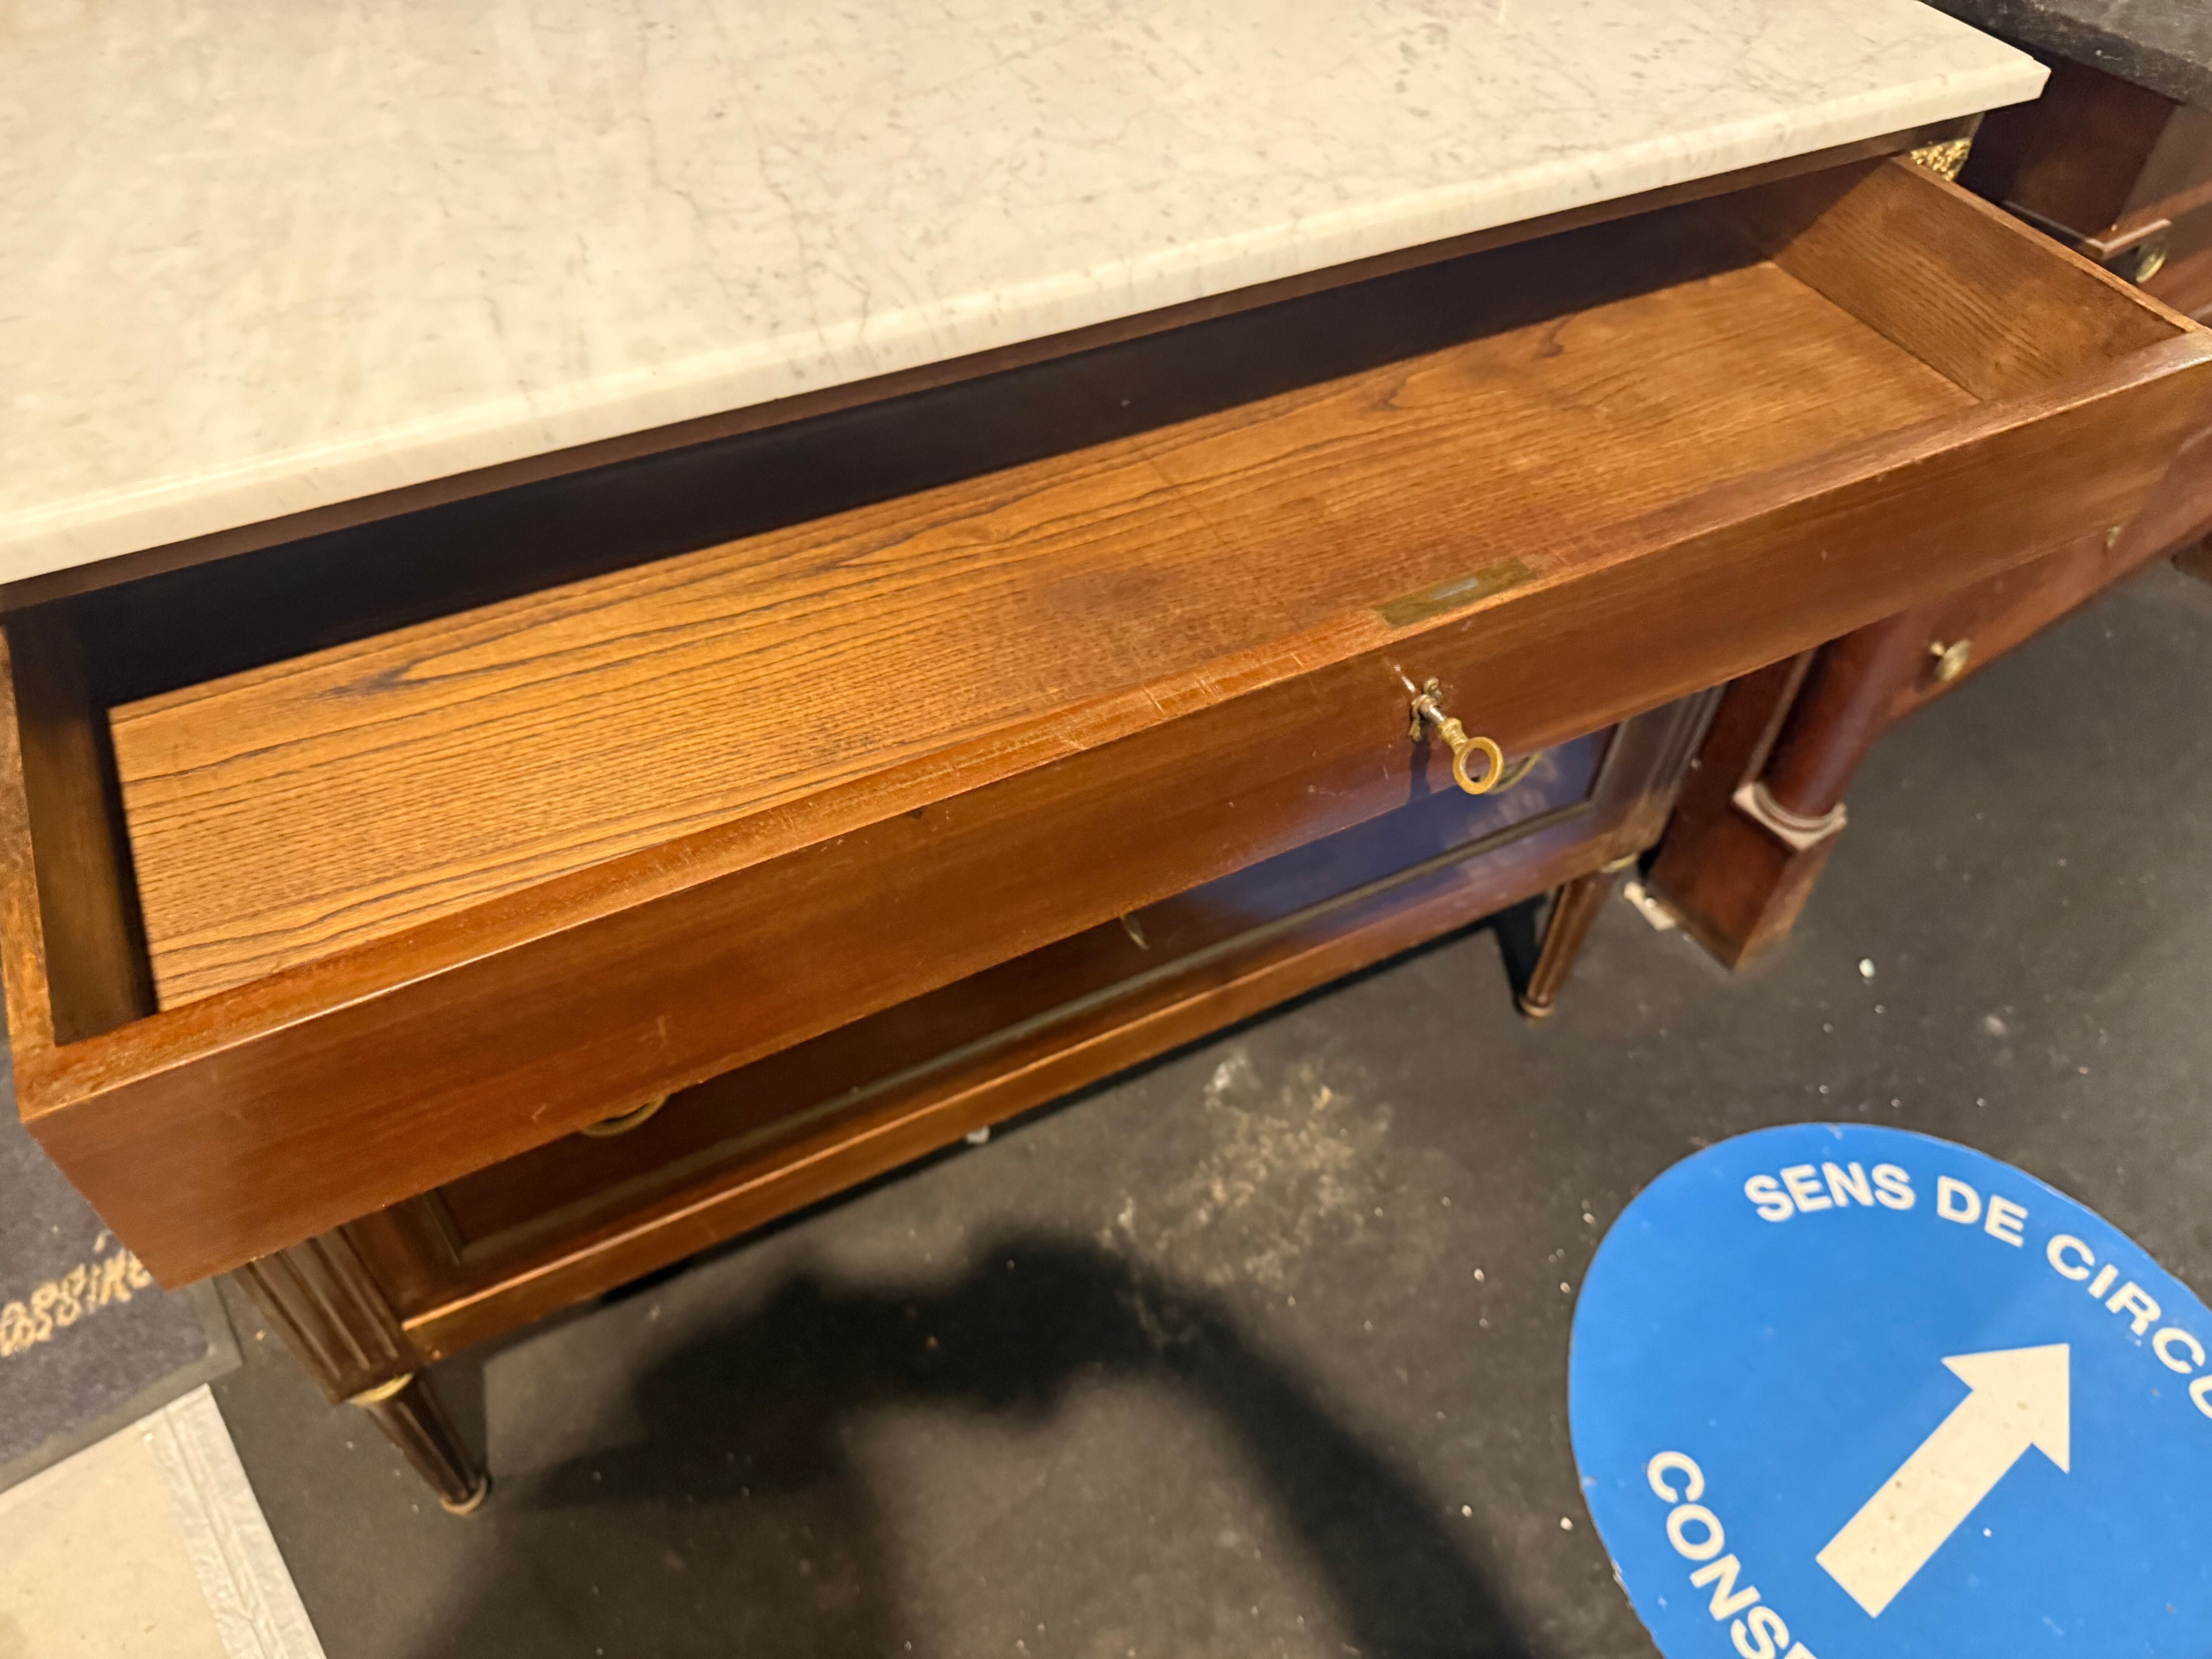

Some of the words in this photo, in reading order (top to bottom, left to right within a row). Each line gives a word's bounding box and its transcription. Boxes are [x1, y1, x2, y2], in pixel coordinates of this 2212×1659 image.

[1744, 1162, 1915, 1222] SENS
[1937, 1176, 2028, 1247] DE
[1647, 1451, 1817, 1659] CONS
